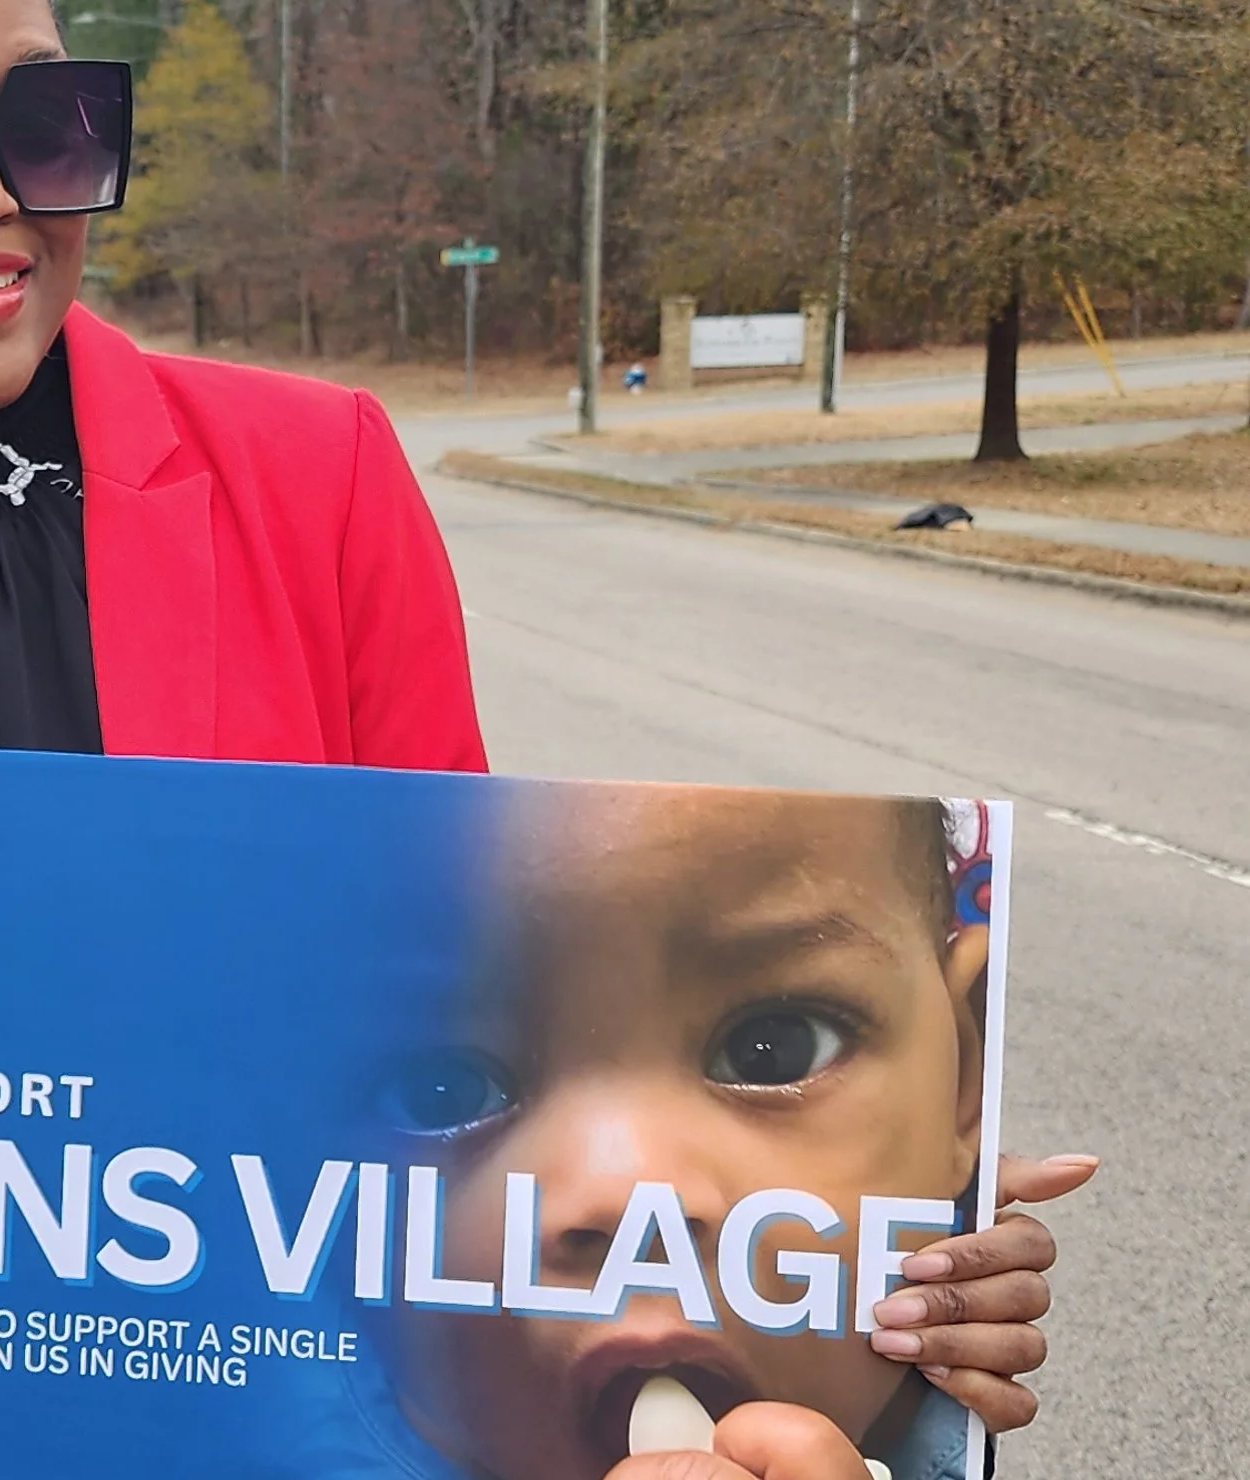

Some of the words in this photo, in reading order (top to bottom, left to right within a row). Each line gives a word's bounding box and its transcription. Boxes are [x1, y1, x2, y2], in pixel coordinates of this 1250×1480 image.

[26, 1312, 189, 1351] SUPPORT
[196, 1323, 221, 1352] A
[230, 1325, 358, 1363] SINGLE
[23, 1344, 69, 1375] US
[79, 1348, 114, 1377] IN
[125, 1350, 248, 1387] GIVING
